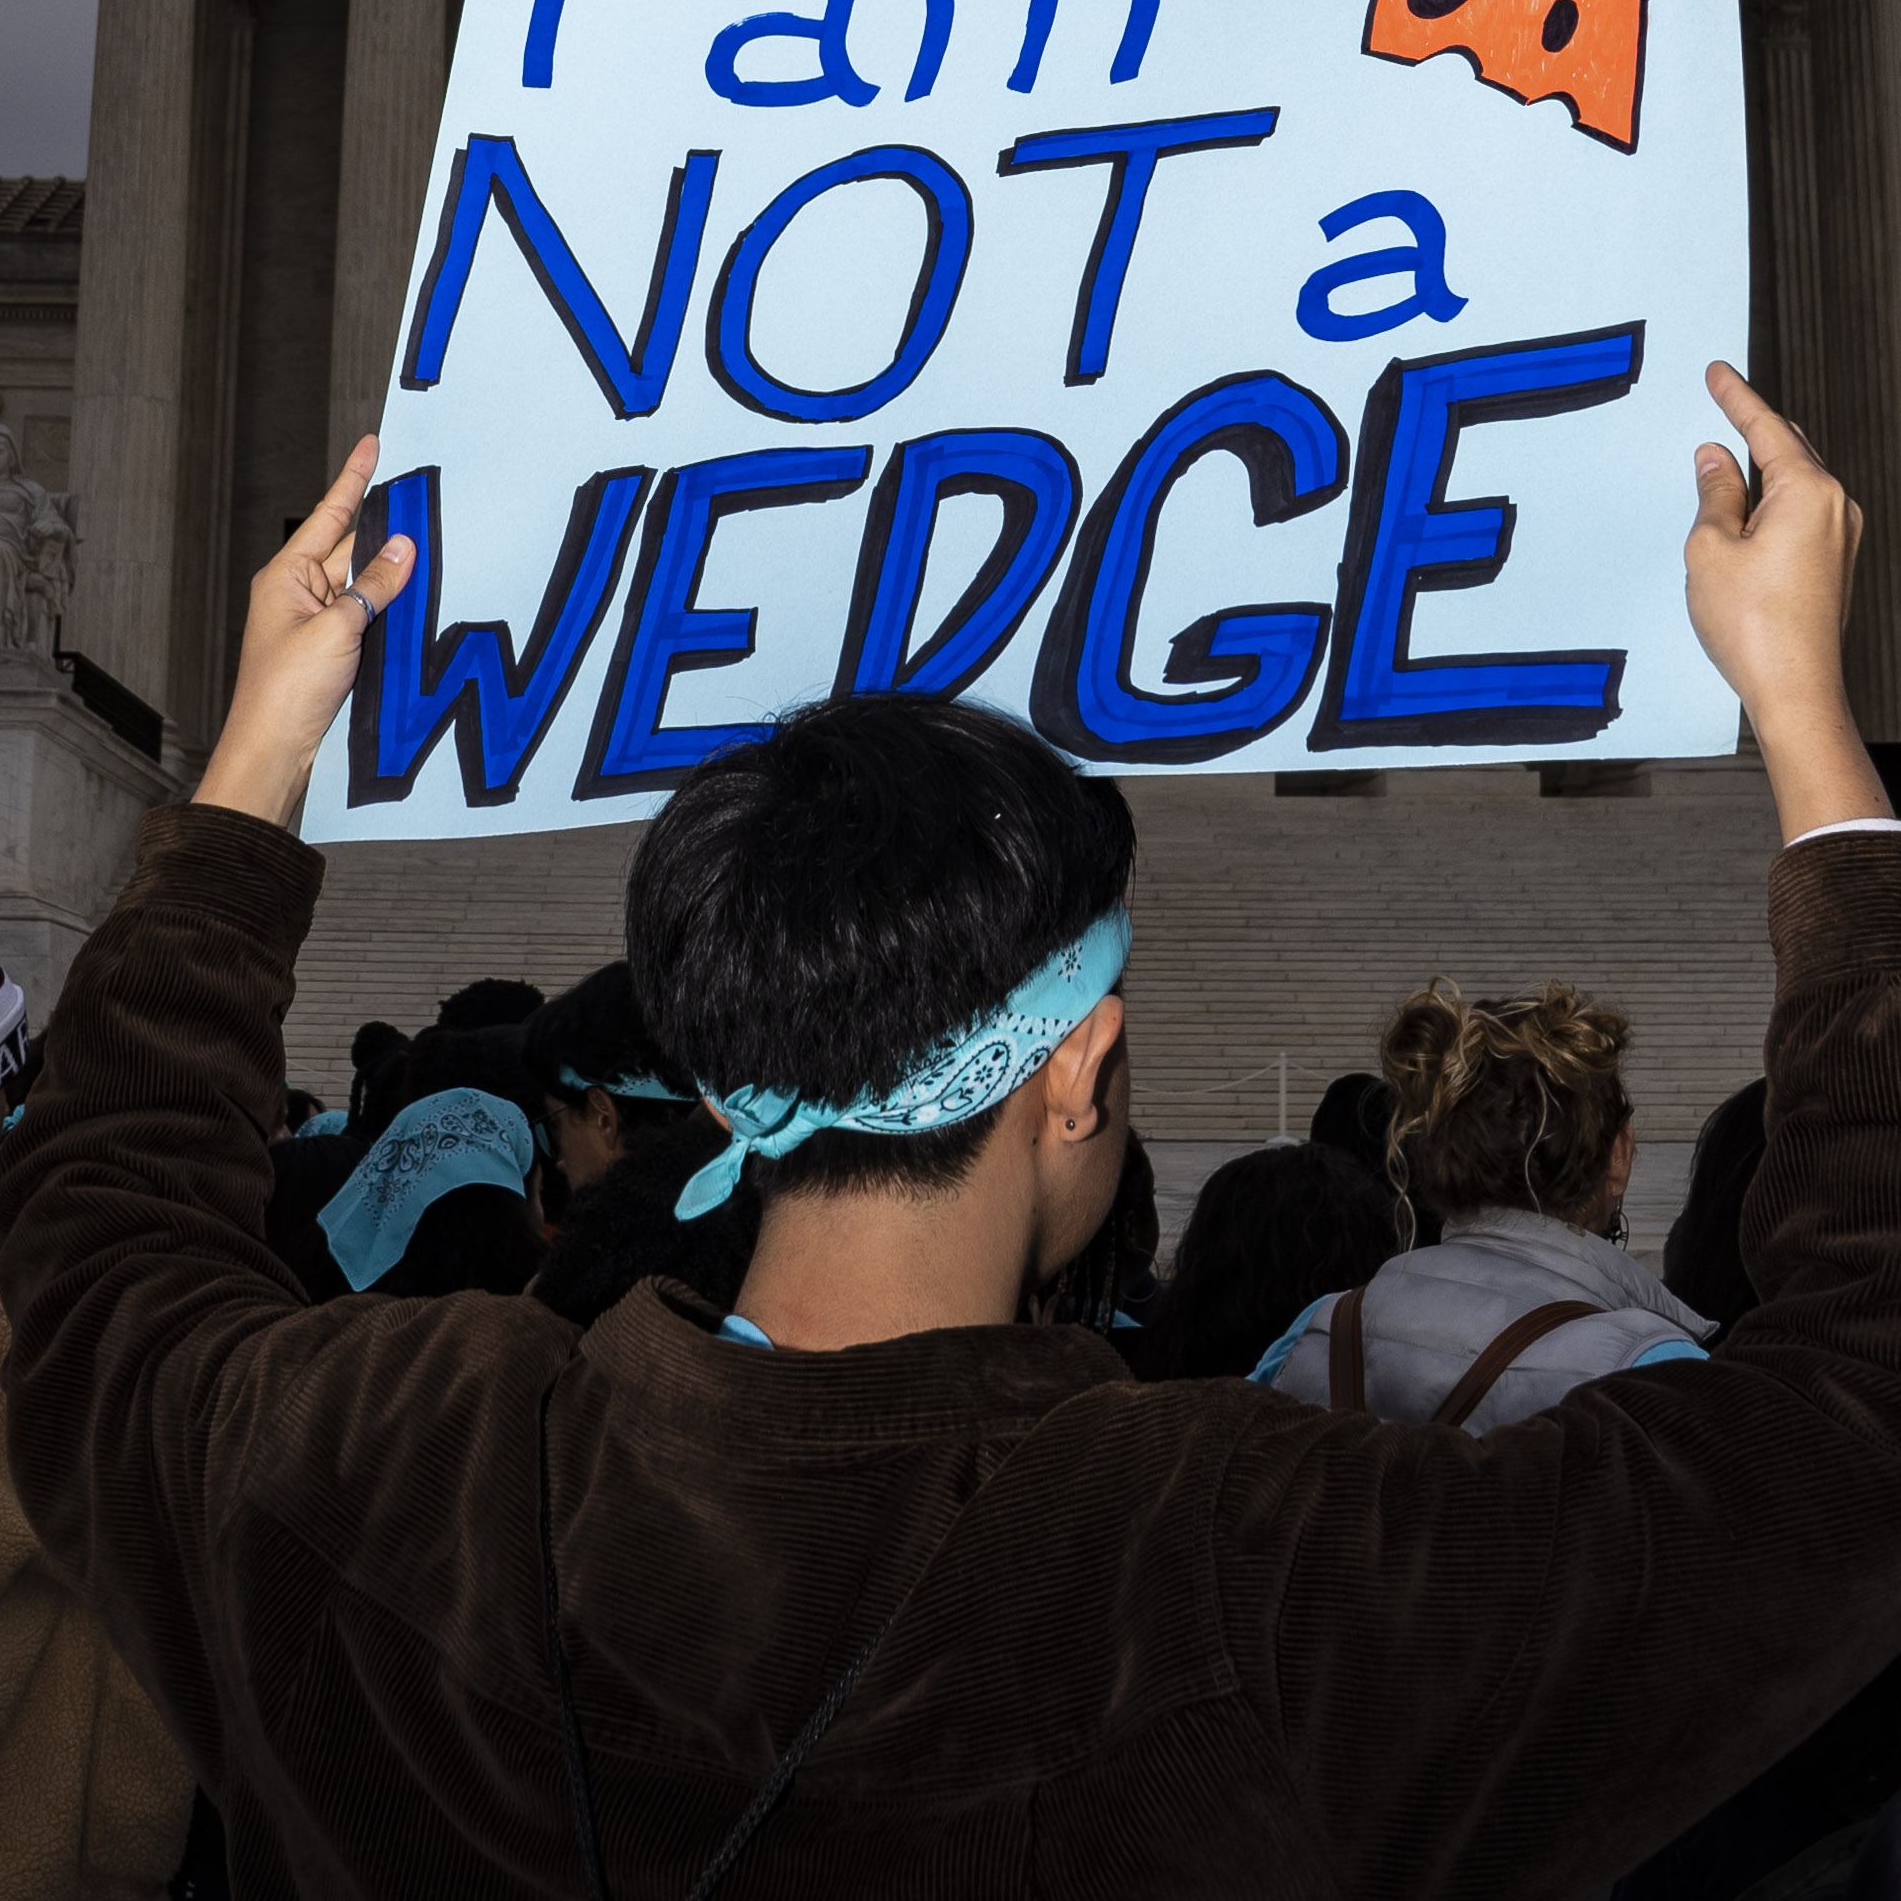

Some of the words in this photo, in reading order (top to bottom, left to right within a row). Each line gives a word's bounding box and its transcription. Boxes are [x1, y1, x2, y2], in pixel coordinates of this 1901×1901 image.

[399, 106, 1282, 423] NOT
[1295, 189, 1469, 343] a
[346, 319, 1646, 808] WEDGE
